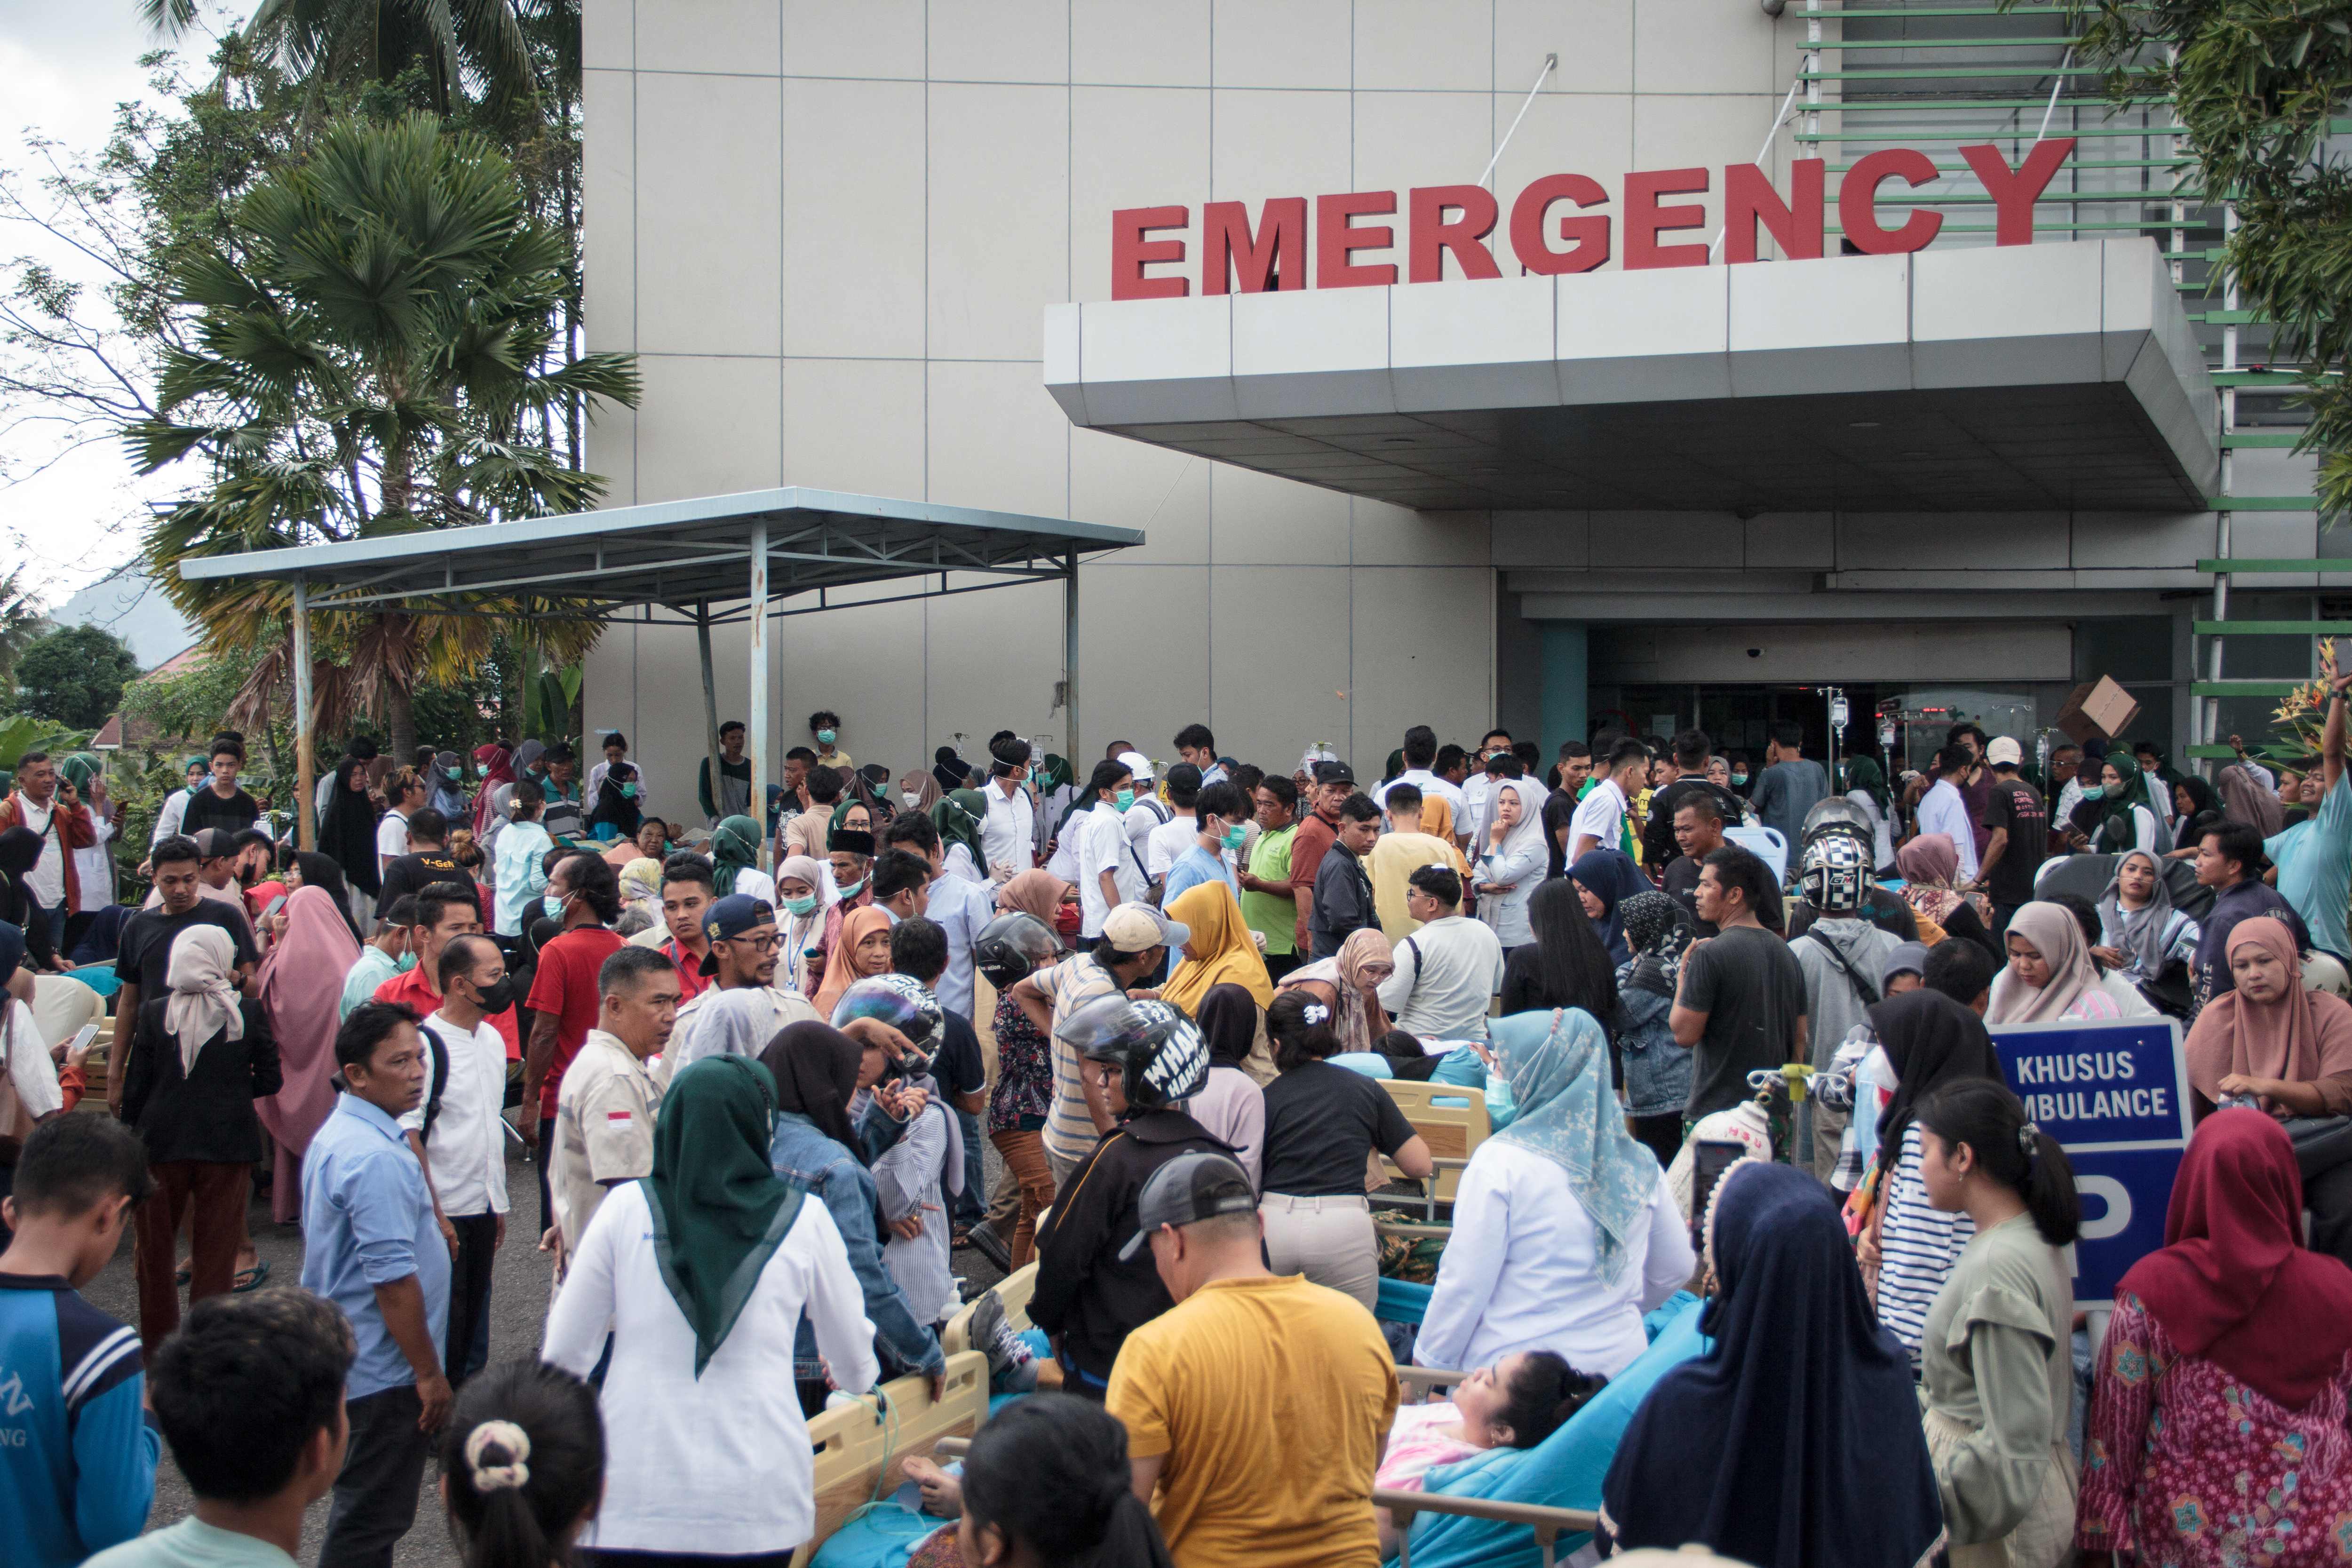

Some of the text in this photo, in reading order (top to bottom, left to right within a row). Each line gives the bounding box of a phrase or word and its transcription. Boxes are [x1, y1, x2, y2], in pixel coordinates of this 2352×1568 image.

[1112, 138, 2075, 301] EMERGENCY
[2017, 1051, 2135, 1084] KHUSUS
[2023, 1088, 2169, 1122] MBULANCE
